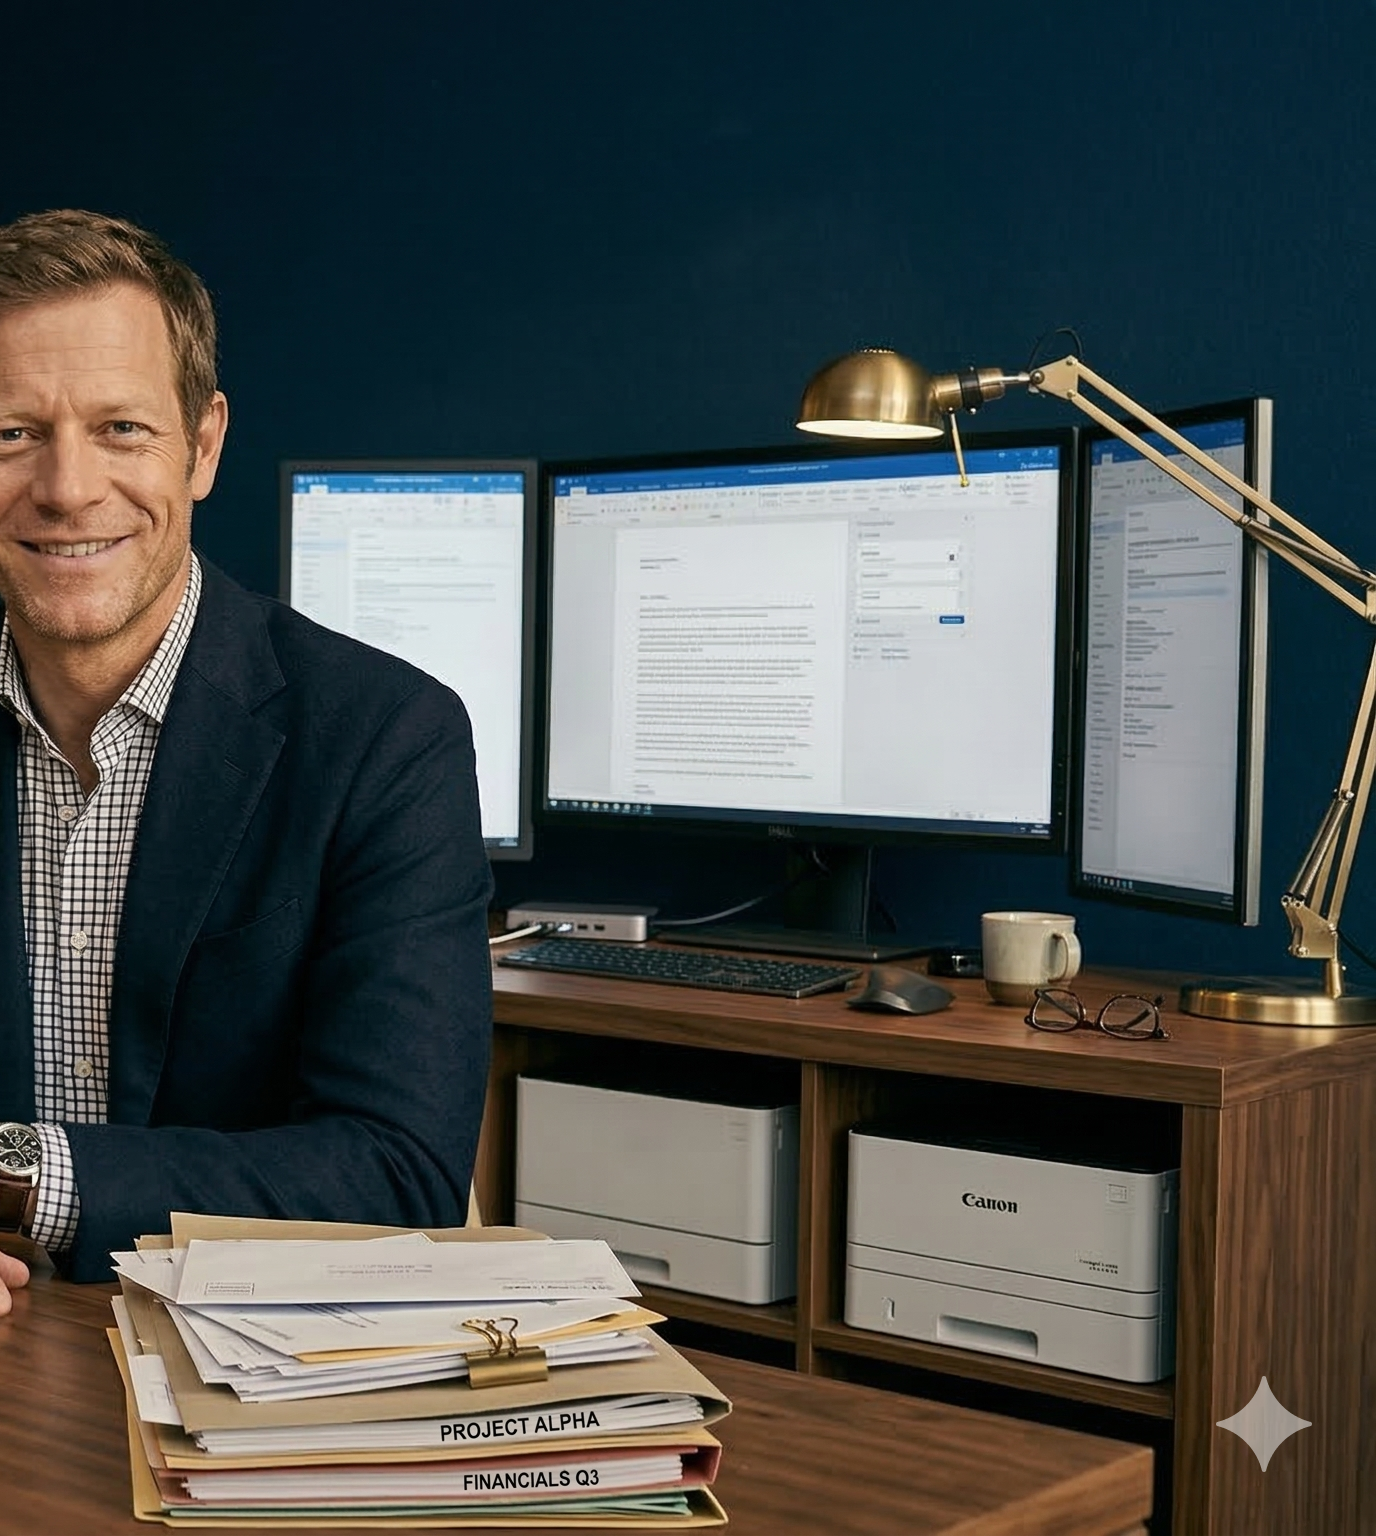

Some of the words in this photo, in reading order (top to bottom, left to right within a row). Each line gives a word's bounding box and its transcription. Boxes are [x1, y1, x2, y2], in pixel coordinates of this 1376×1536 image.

[961, 1192, 1018, 1214] Canon
[440, 1417, 529, 1442] PROJECT
[534, 1410, 600, 1434] ALPHA
[463, 1469, 571, 1491] FINANCIALS
[575, 1468, 600, 1487] Q3
